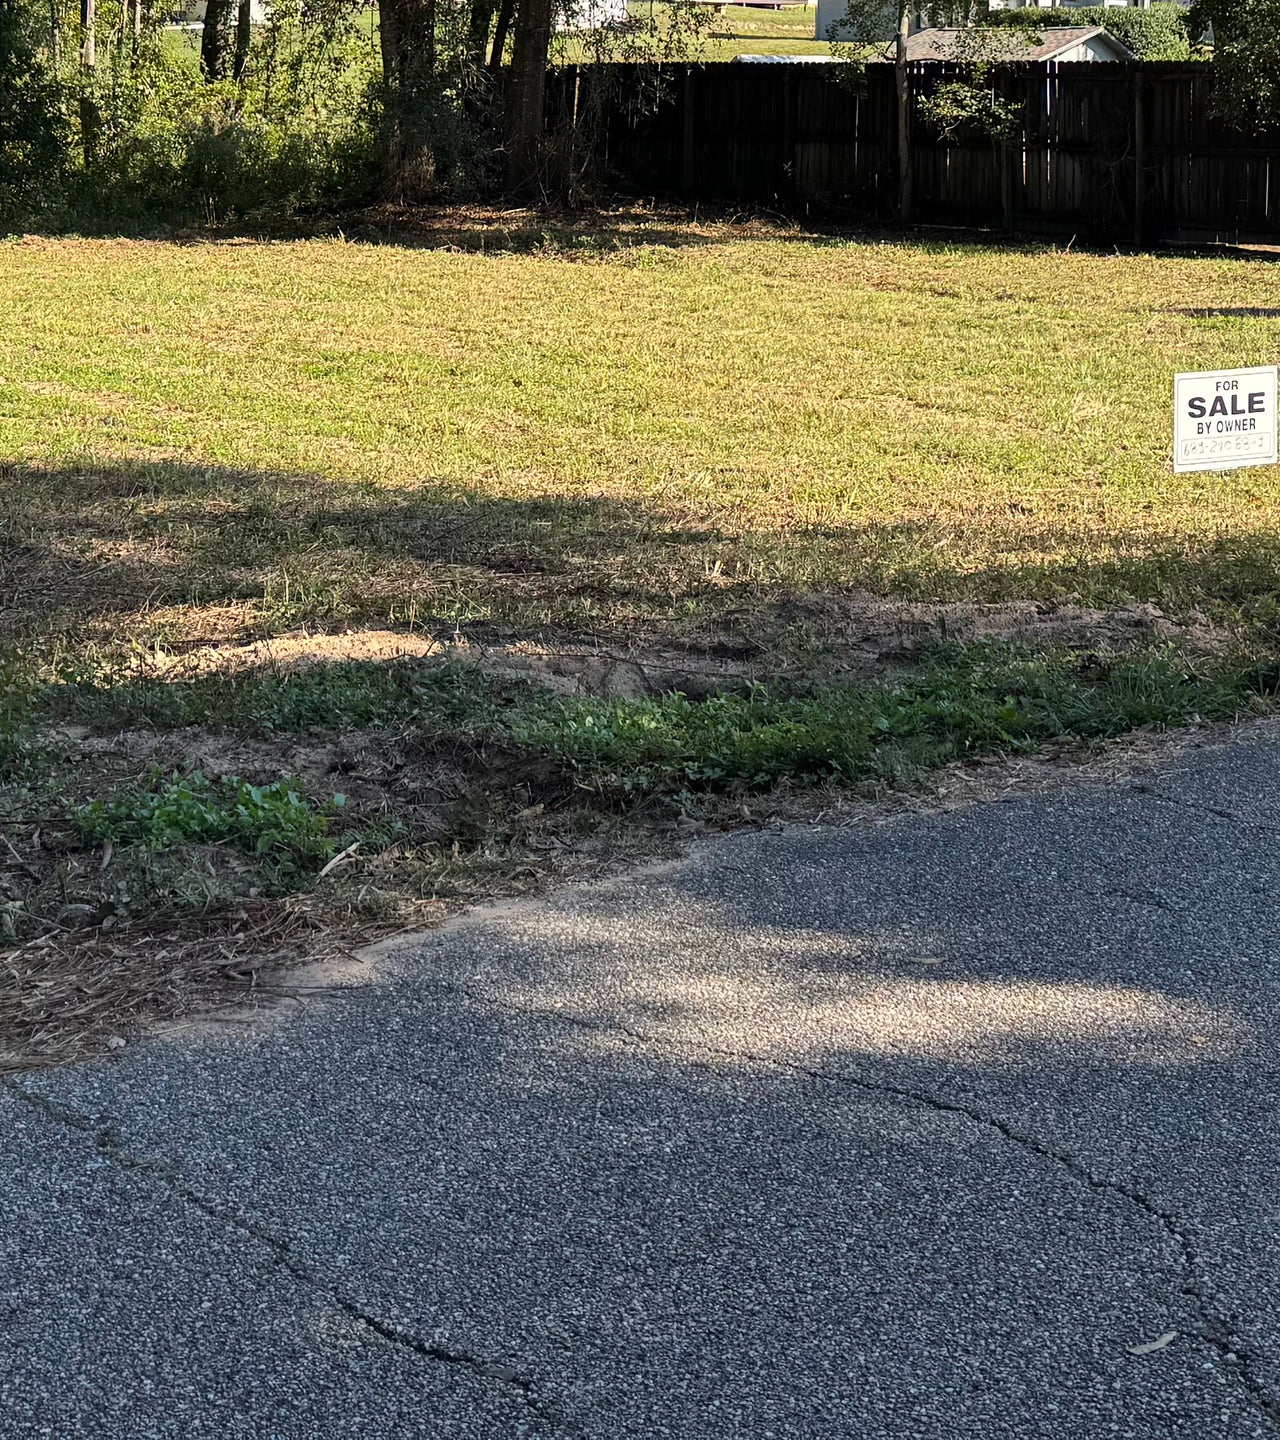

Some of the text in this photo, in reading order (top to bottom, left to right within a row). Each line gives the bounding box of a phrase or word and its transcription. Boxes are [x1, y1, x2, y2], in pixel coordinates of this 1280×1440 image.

[1215, 380, 1239, 392] FOR
[1188, 392, 1265, 419] SALE
[1197, 418, 1256, 435] BY OWNER
